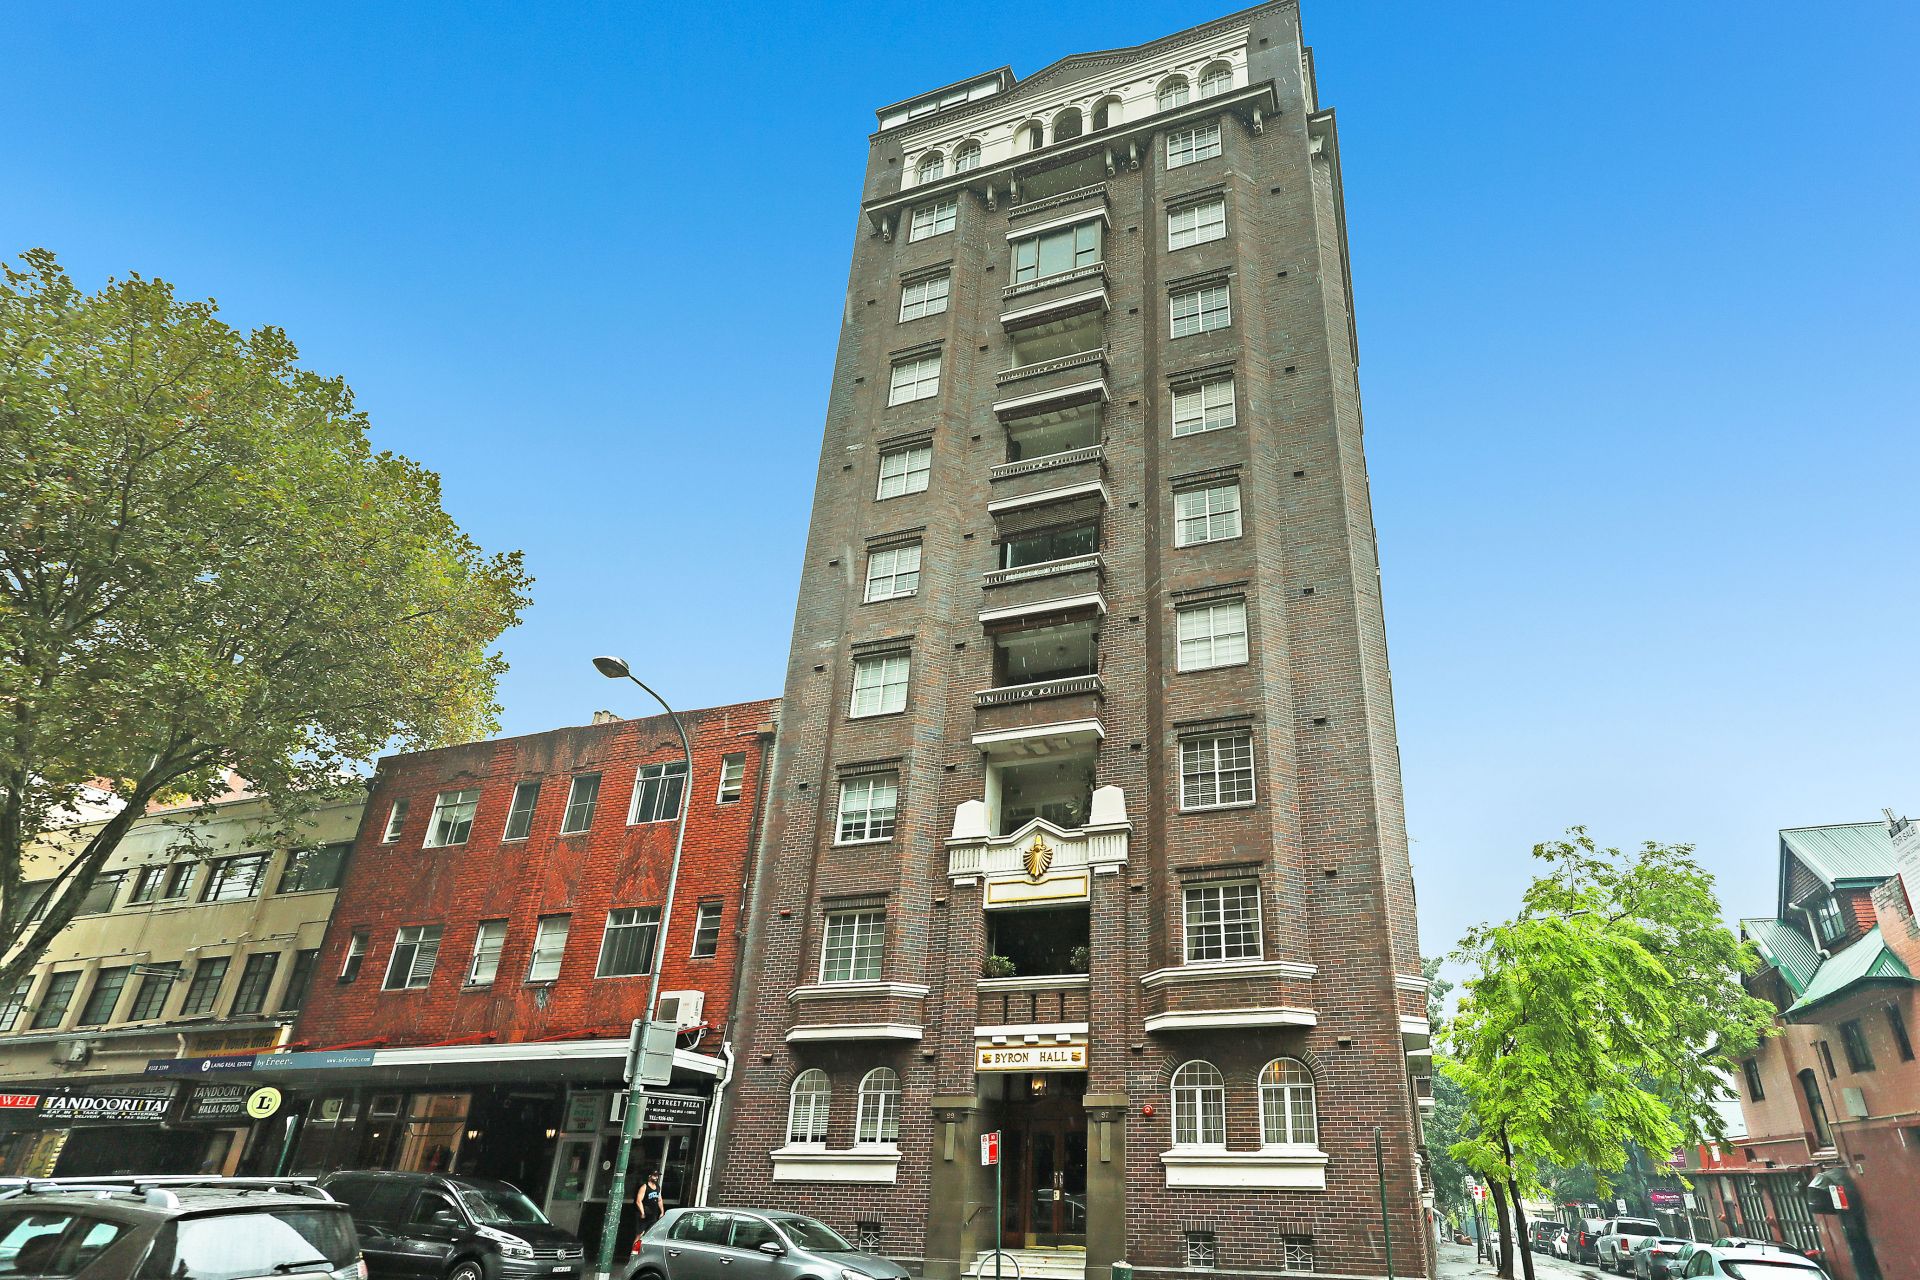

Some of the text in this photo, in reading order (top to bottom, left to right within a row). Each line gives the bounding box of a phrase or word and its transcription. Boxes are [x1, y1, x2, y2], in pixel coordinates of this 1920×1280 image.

[995, 1051, 1068, 1063] BYRON HALL
[194, 1086, 240, 1098] TANDOORI
[46, 1096, 170, 1114] TANDOORI TAJ
[198, 1104, 240, 1114] HALAL FOOD
[658, 1099, 681, 1107] STREET
[683, 1101, 700, 1109] PIZZA
[1101, 1111, 1109, 1119] 97
